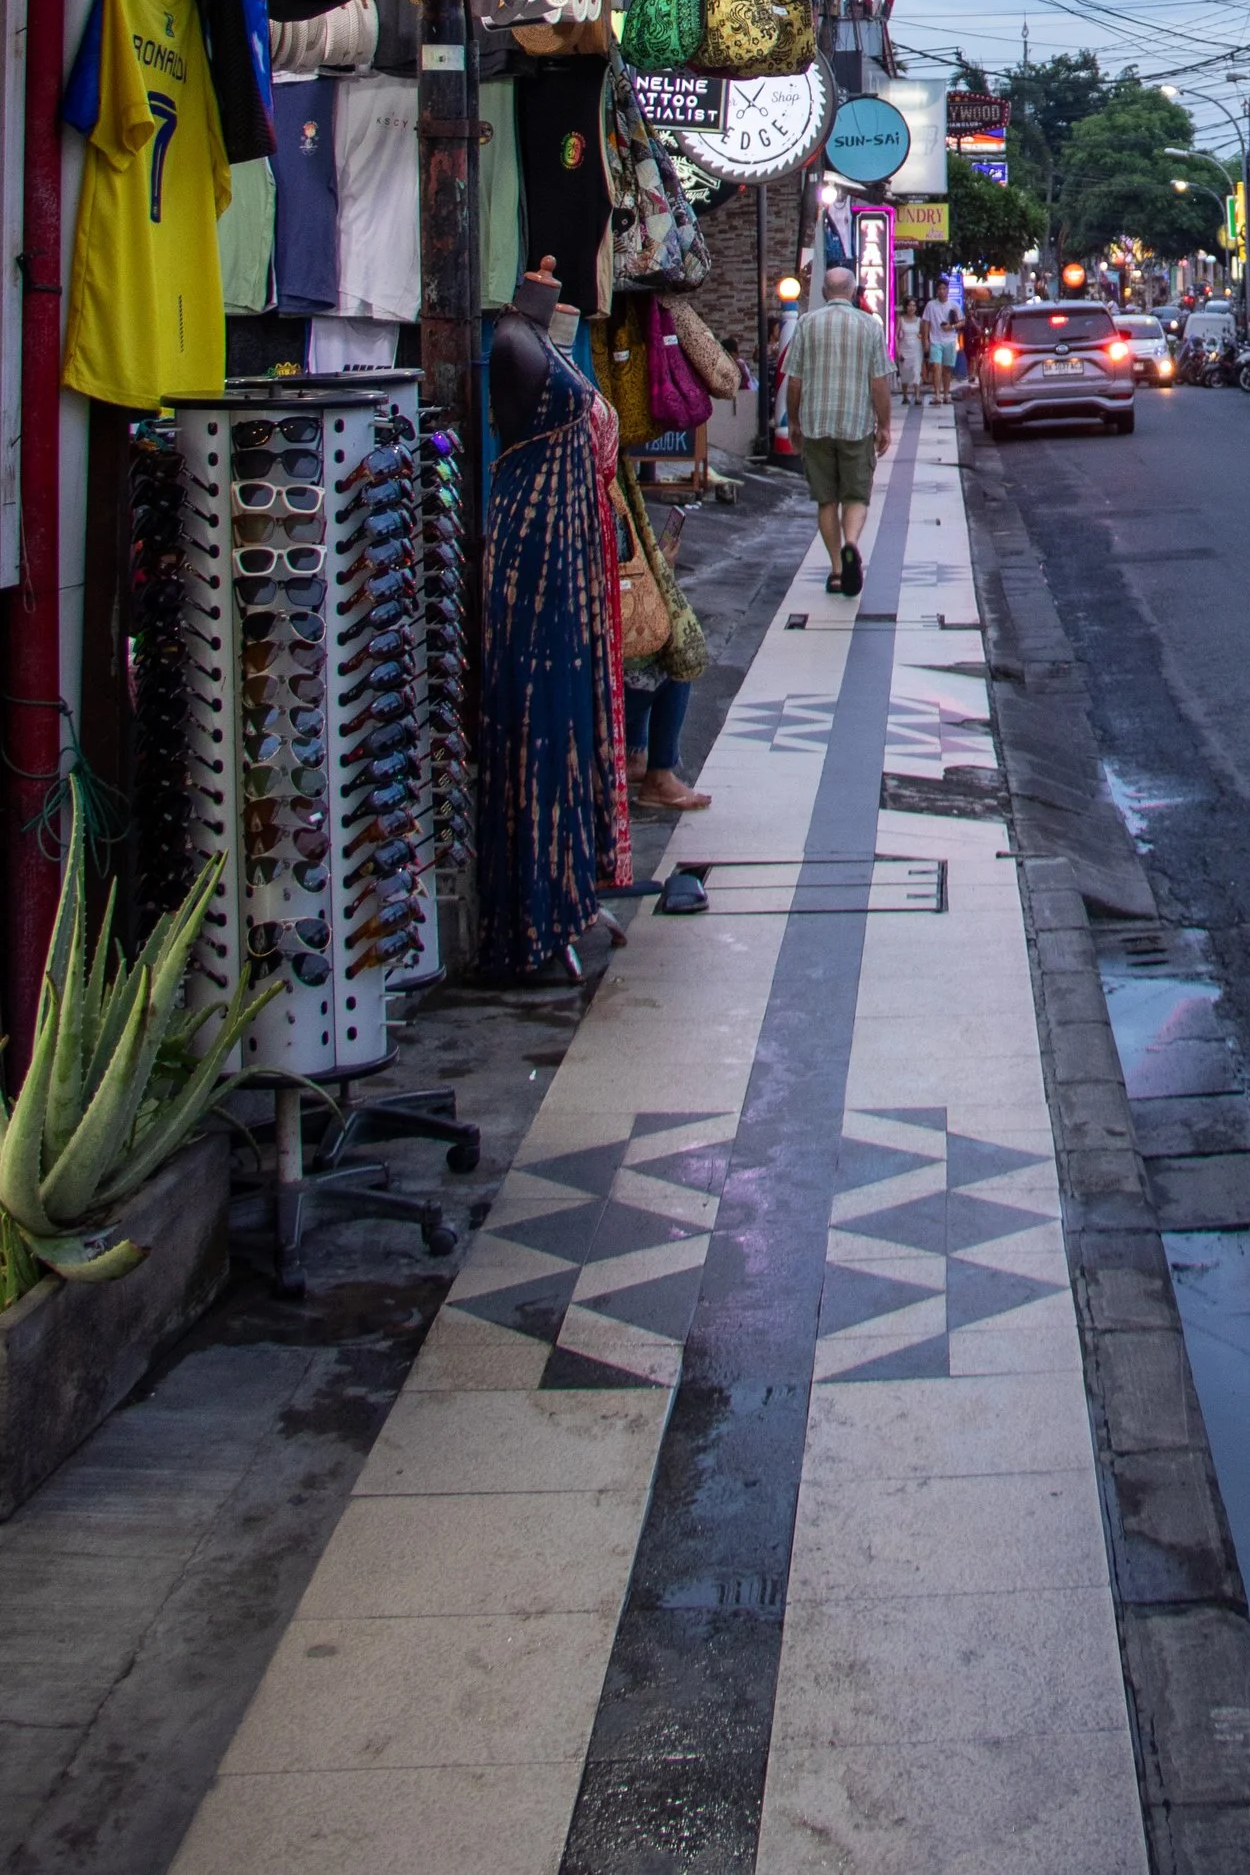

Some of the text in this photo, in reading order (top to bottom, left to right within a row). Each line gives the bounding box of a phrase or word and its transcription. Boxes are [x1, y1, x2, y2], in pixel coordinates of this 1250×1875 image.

[133, 33, 187, 84] RONALD
[636, 76, 709, 94] NELINE
[771, 91, 800, 107] Shop
[644, 107, 718, 124] CIALIST
[949, 104, 1001, 122] YWOOD
[147, 90, 178, 223] 7
[896, 206, 944, 225] UNDRY
[645, 430, 688, 452] BOOK
